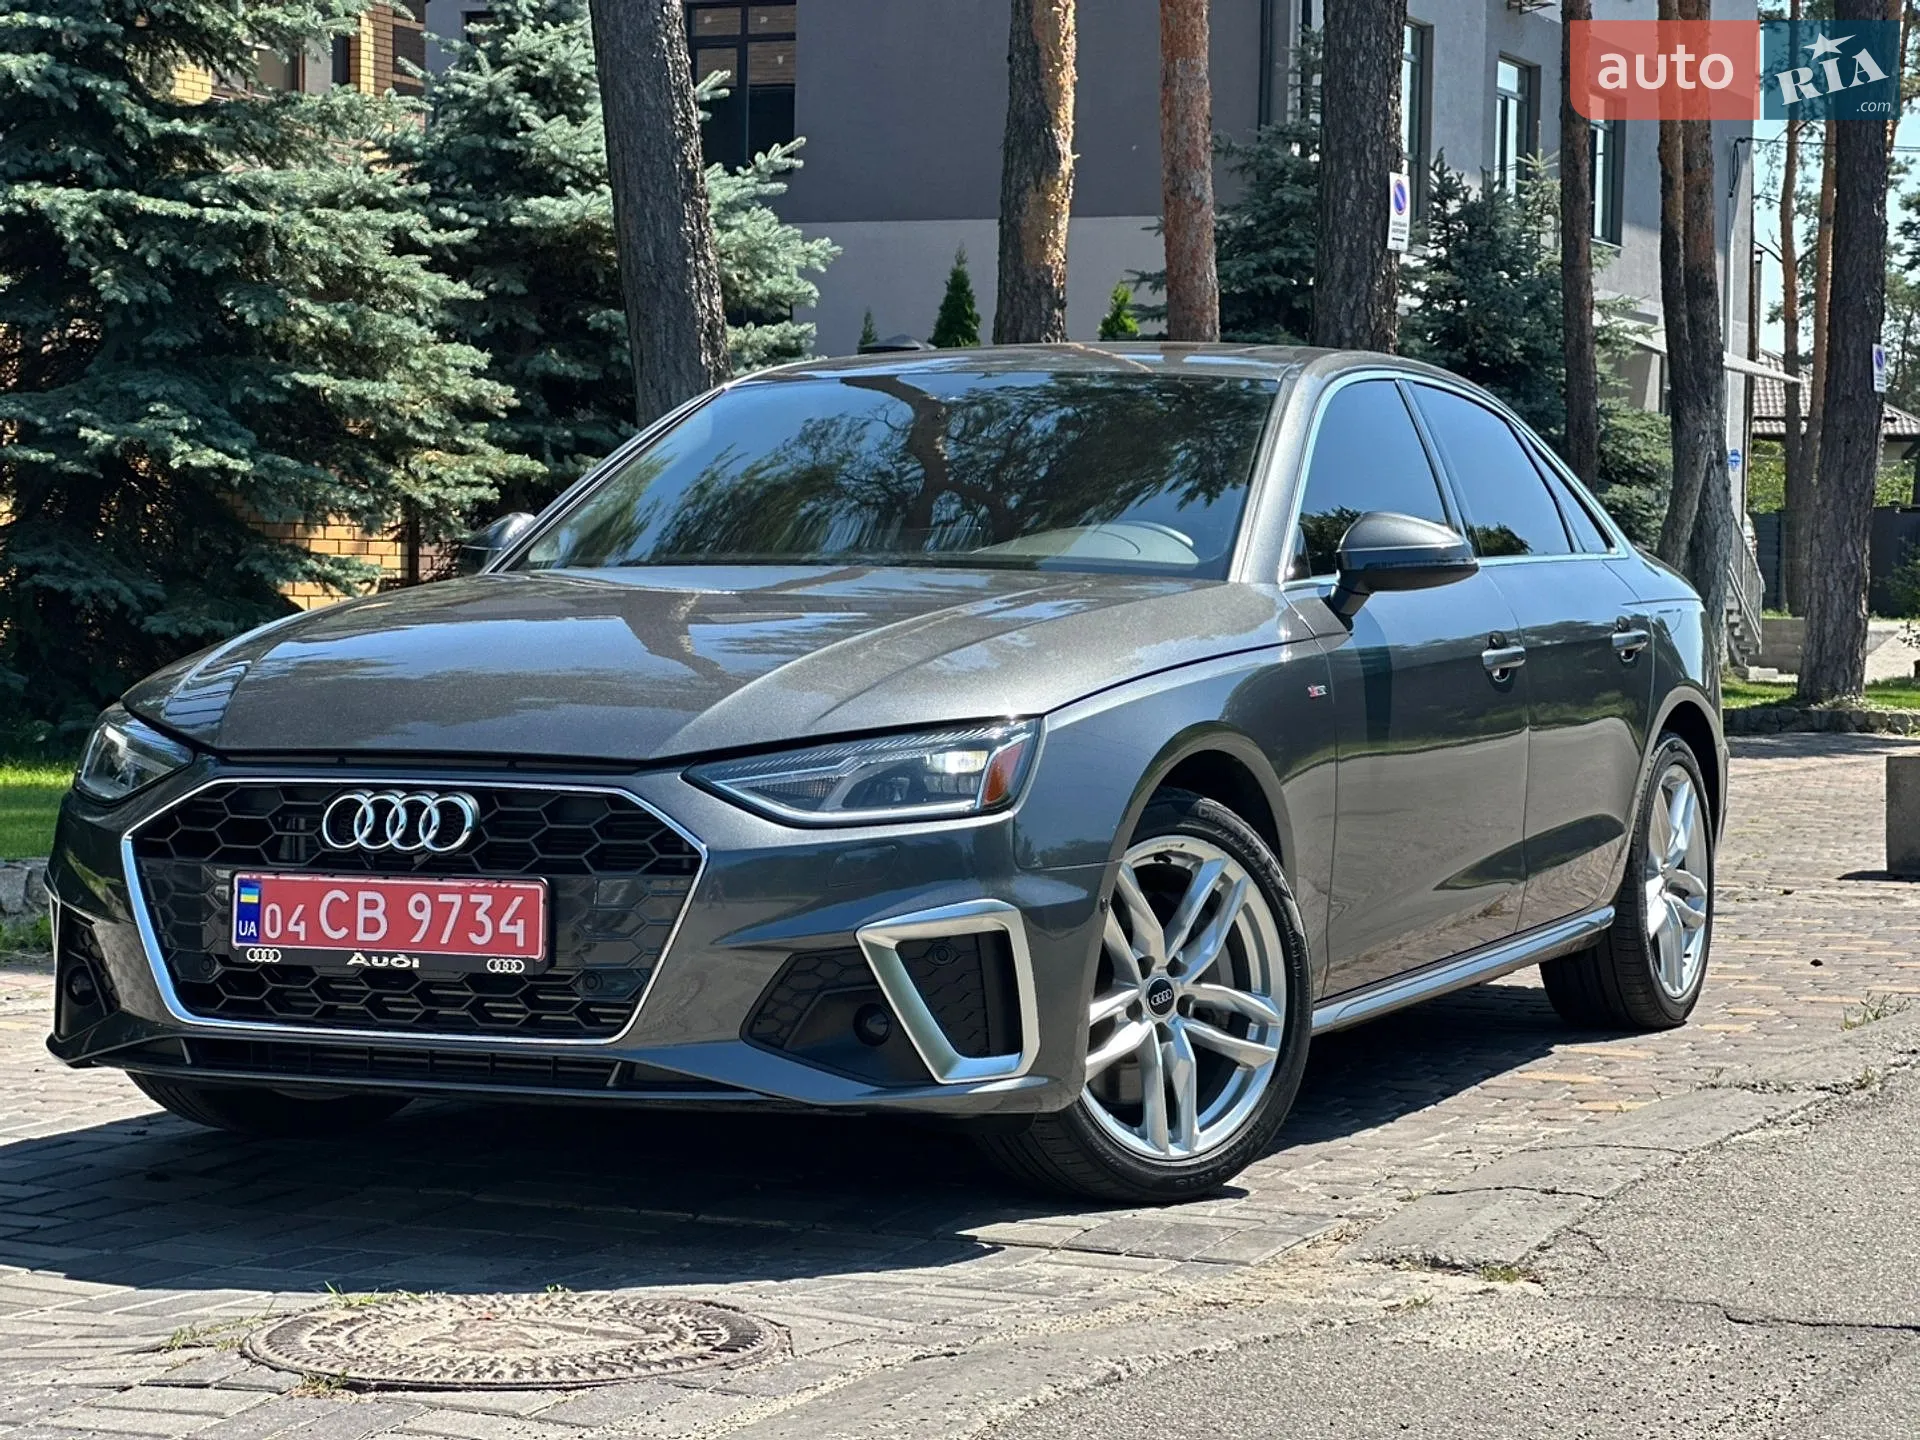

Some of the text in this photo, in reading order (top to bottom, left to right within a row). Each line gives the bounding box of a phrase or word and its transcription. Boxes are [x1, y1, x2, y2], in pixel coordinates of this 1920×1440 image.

[239, 920, 257, 937] UA
[264, 890, 524, 947] 04 CB 9734
